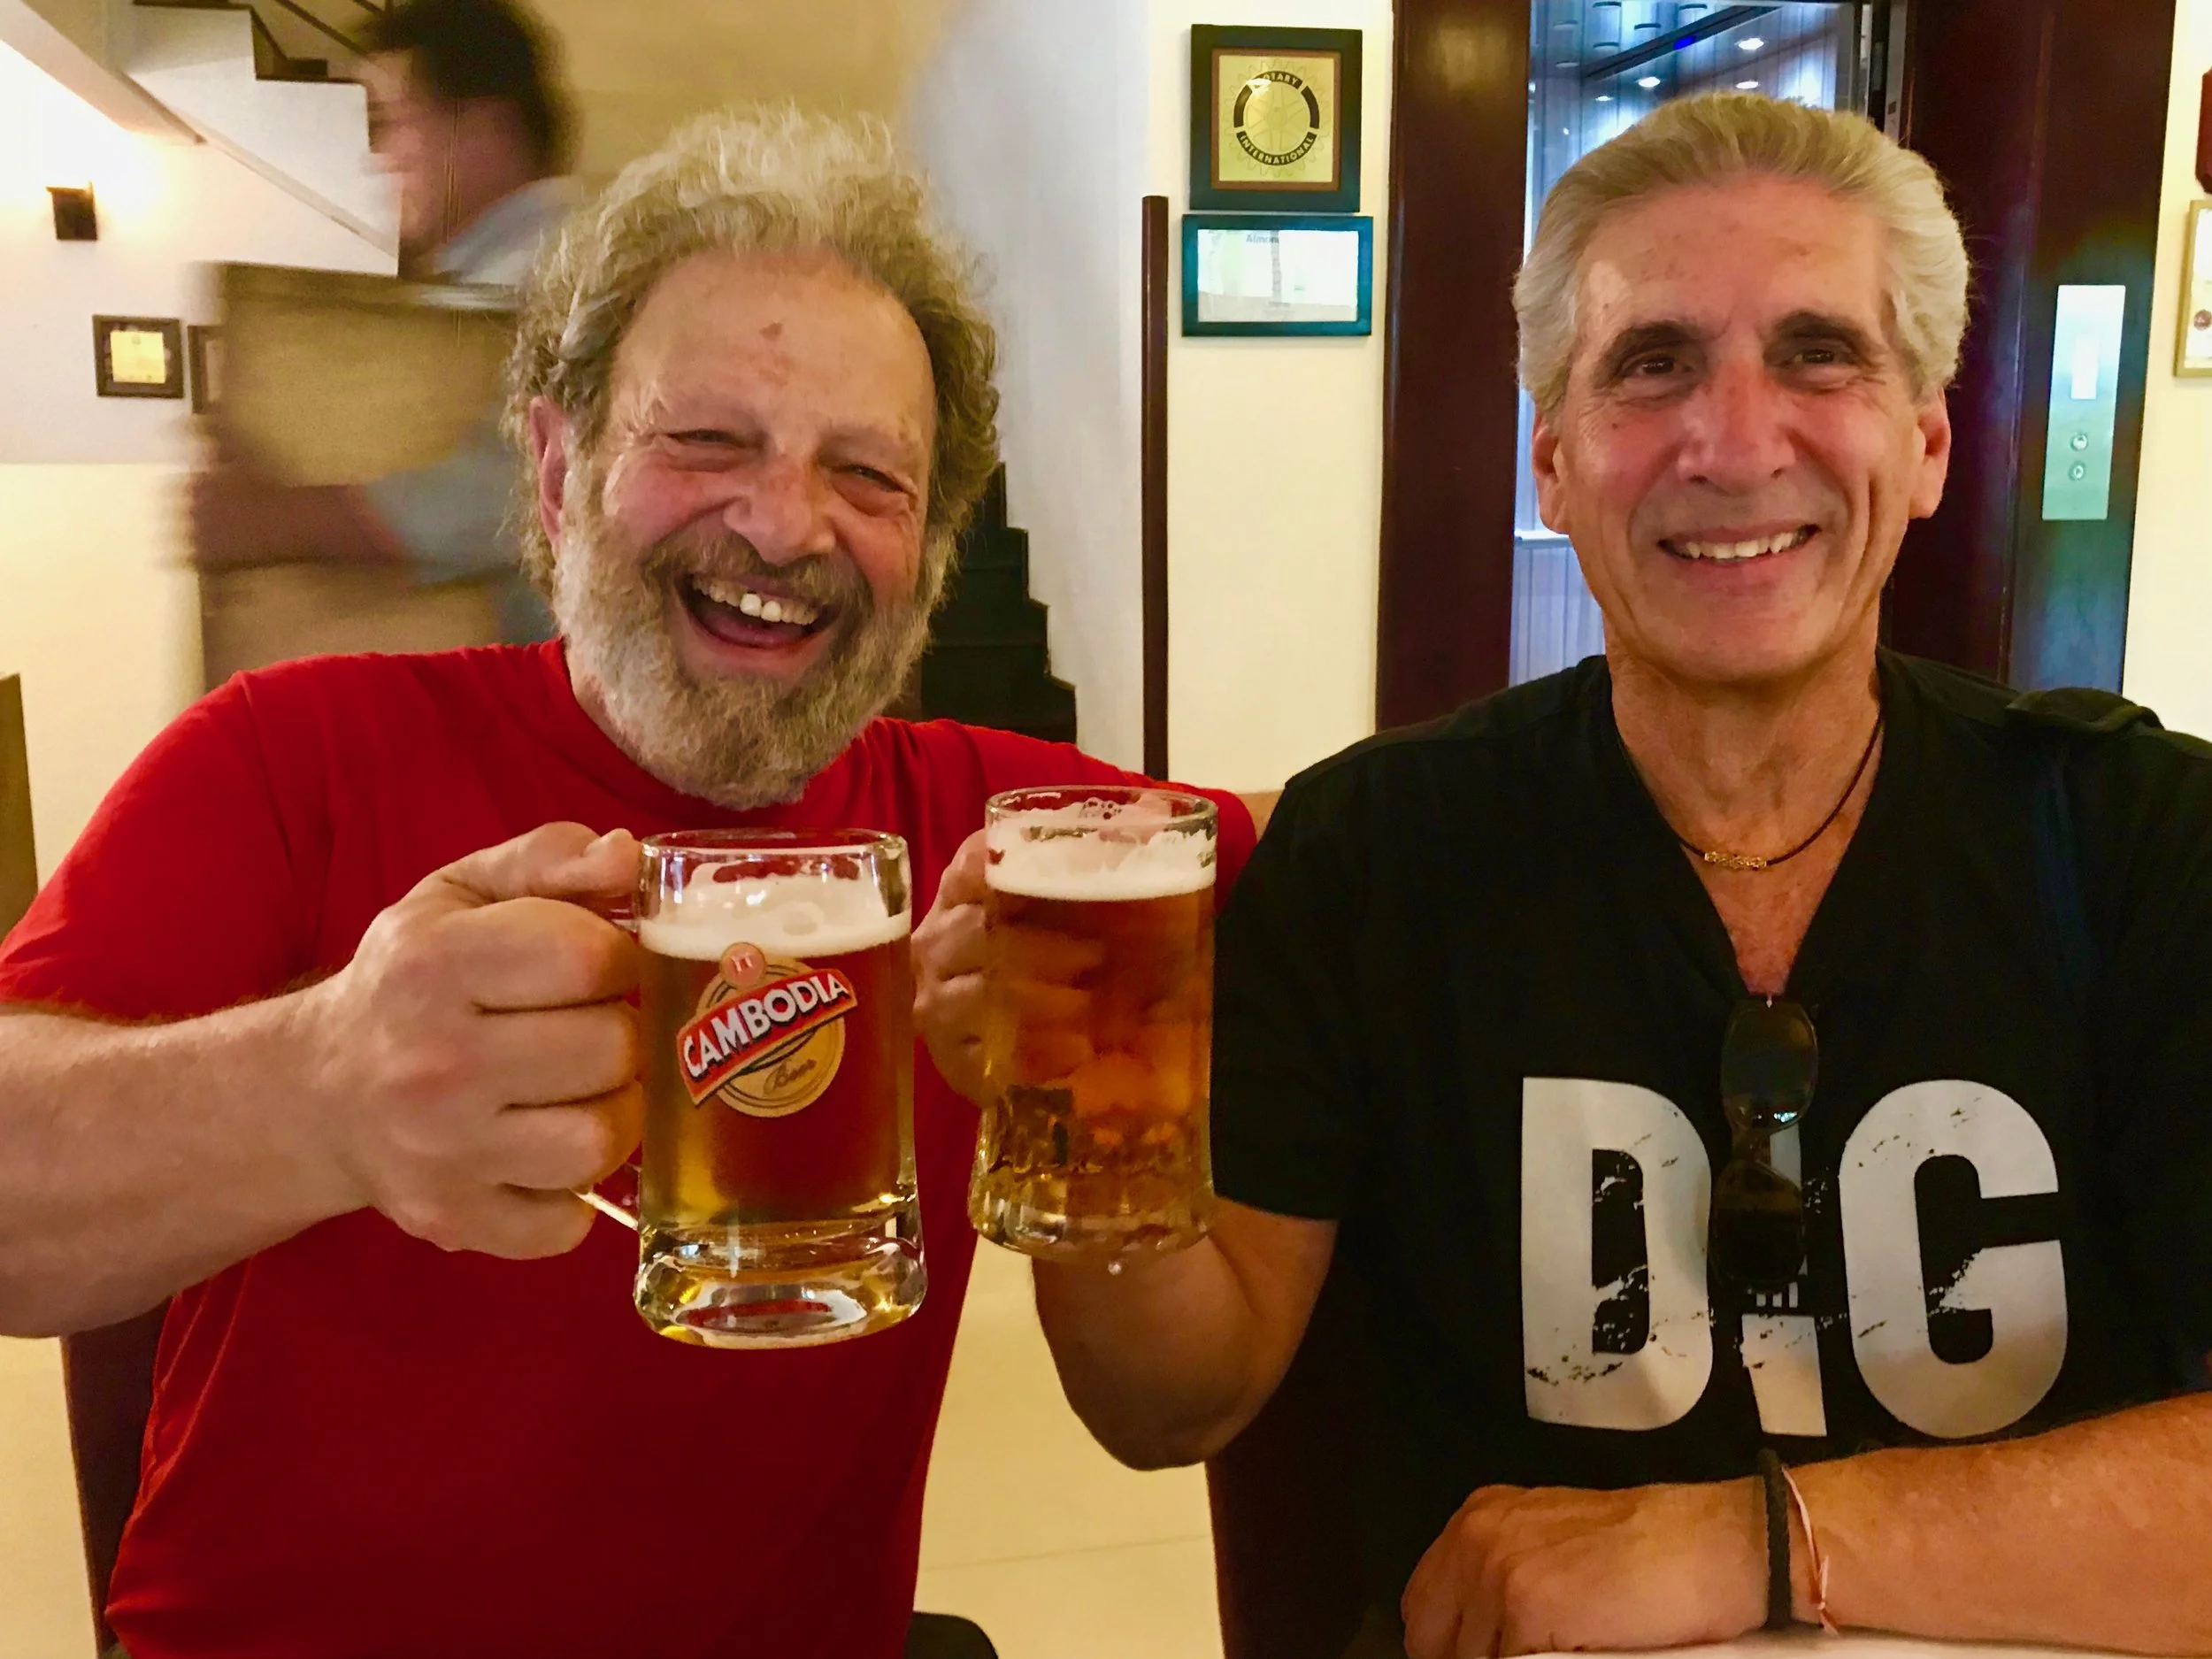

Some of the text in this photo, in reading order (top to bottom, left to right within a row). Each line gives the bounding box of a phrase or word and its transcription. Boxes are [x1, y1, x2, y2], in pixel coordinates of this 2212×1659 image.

[1254, 73, 1298, 86] OTARY
[1240, 134, 1314, 164] INTERNATIONAL
[684, 973, 849, 1079] CAMBODIA
